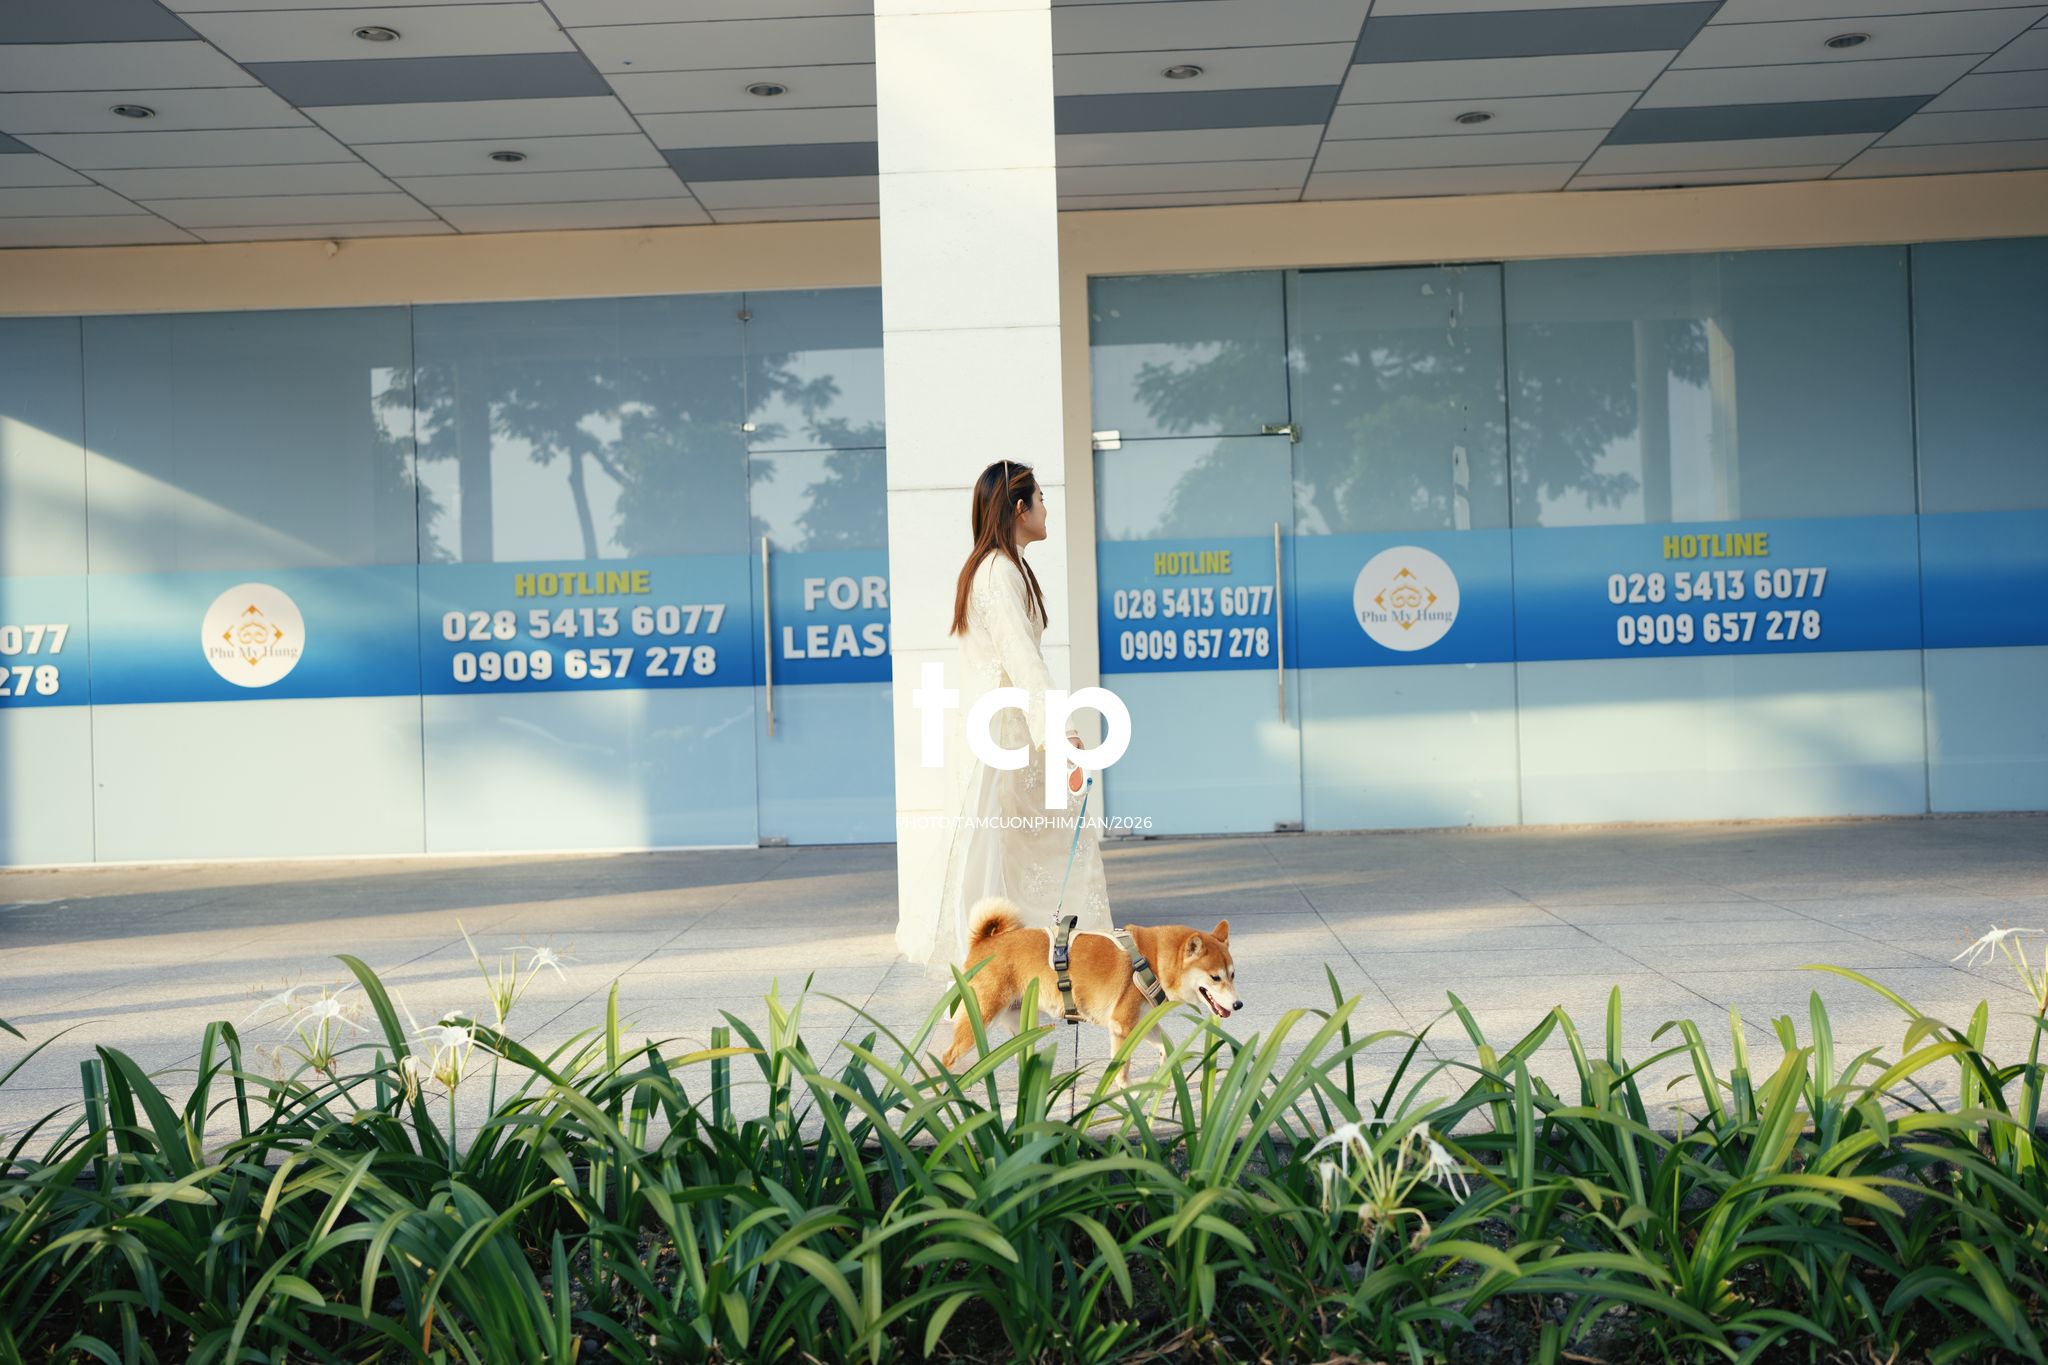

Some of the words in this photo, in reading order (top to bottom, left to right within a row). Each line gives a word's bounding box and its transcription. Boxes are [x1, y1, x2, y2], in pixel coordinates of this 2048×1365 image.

[1154, 550, 1232, 576] HOTLINE
[1663, 532, 1769, 559] HOTLINE
[515, 570, 651, 598] HOTLINE
[804, 576, 888, 611] FOR
[1608, 572, 1666, 605] 028
[1674, 570, 1745, 602] 5413
[1753, 567, 1827, 600] 6077
[1114, 589, 1157, 620] 028
[1162, 587, 1214, 618] 5413
[1220, 585, 1274, 616] 6077
[1362, 611, 1387, 623] Phu
[1416, 609, 1453, 623] Hung
[442, 609, 517, 642] 028
[529, 607, 619, 639] 5413
[631, 603, 726, 636] 6077
[1617, 613, 1694, 646] 0909
[1703, 611, 1757, 643] 657
[1766, 609, 1821, 640] 278
[210, 647, 235, 659] Phu
[263, 646, 298, 659] Hung
[783, 623, 892, 660] LEAS
[1120, 629, 1177, 661] 0909
[1183, 628, 1223, 659] 657
[1229, 627, 1270, 658] 278
[453, 650, 552, 683] 0909
[564, 647, 635, 679] 657
[645, 645, 717, 677] 278
